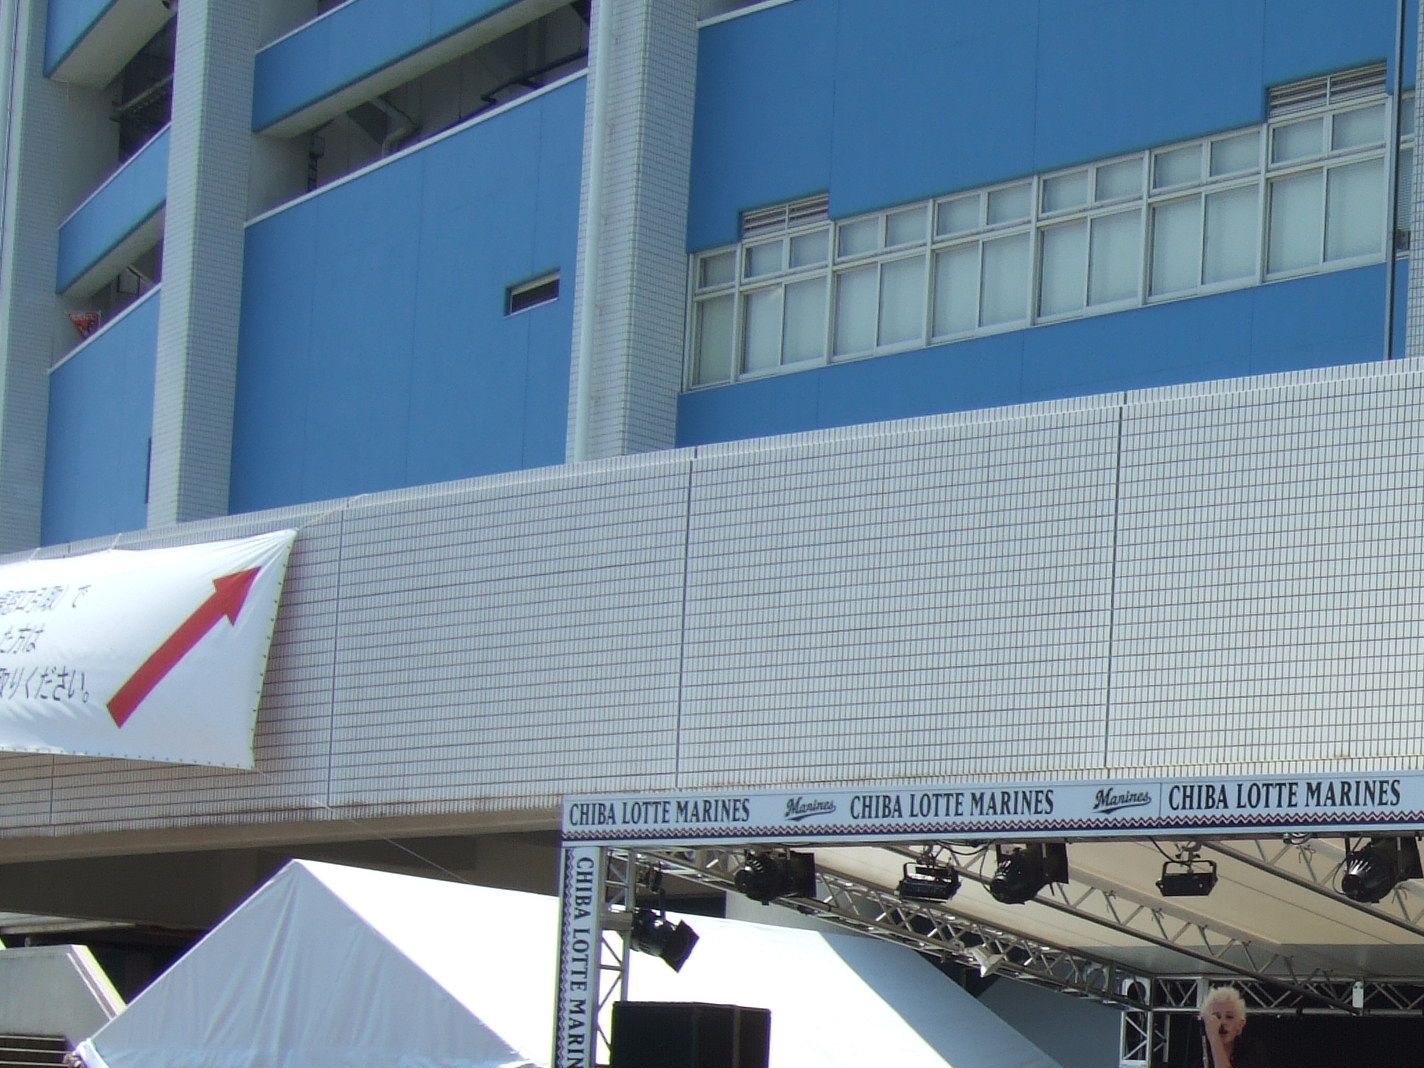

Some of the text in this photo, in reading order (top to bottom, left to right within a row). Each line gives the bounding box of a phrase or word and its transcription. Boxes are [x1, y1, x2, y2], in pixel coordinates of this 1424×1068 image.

[784, 796, 837, 821] Marines
[850, 789, 1054, 819] CHIBA LOTTE MARINES
[1092, 787, 1152, 814] Marines
[1169, 779, 1401, 810] CHIBA LOTTE MARINES
[570, 798, 750, 826] CHIBA LOTTE MARINES
[573, 856, 595, 920] CHIBA
[569, 927, 591, 992] LOTTE
